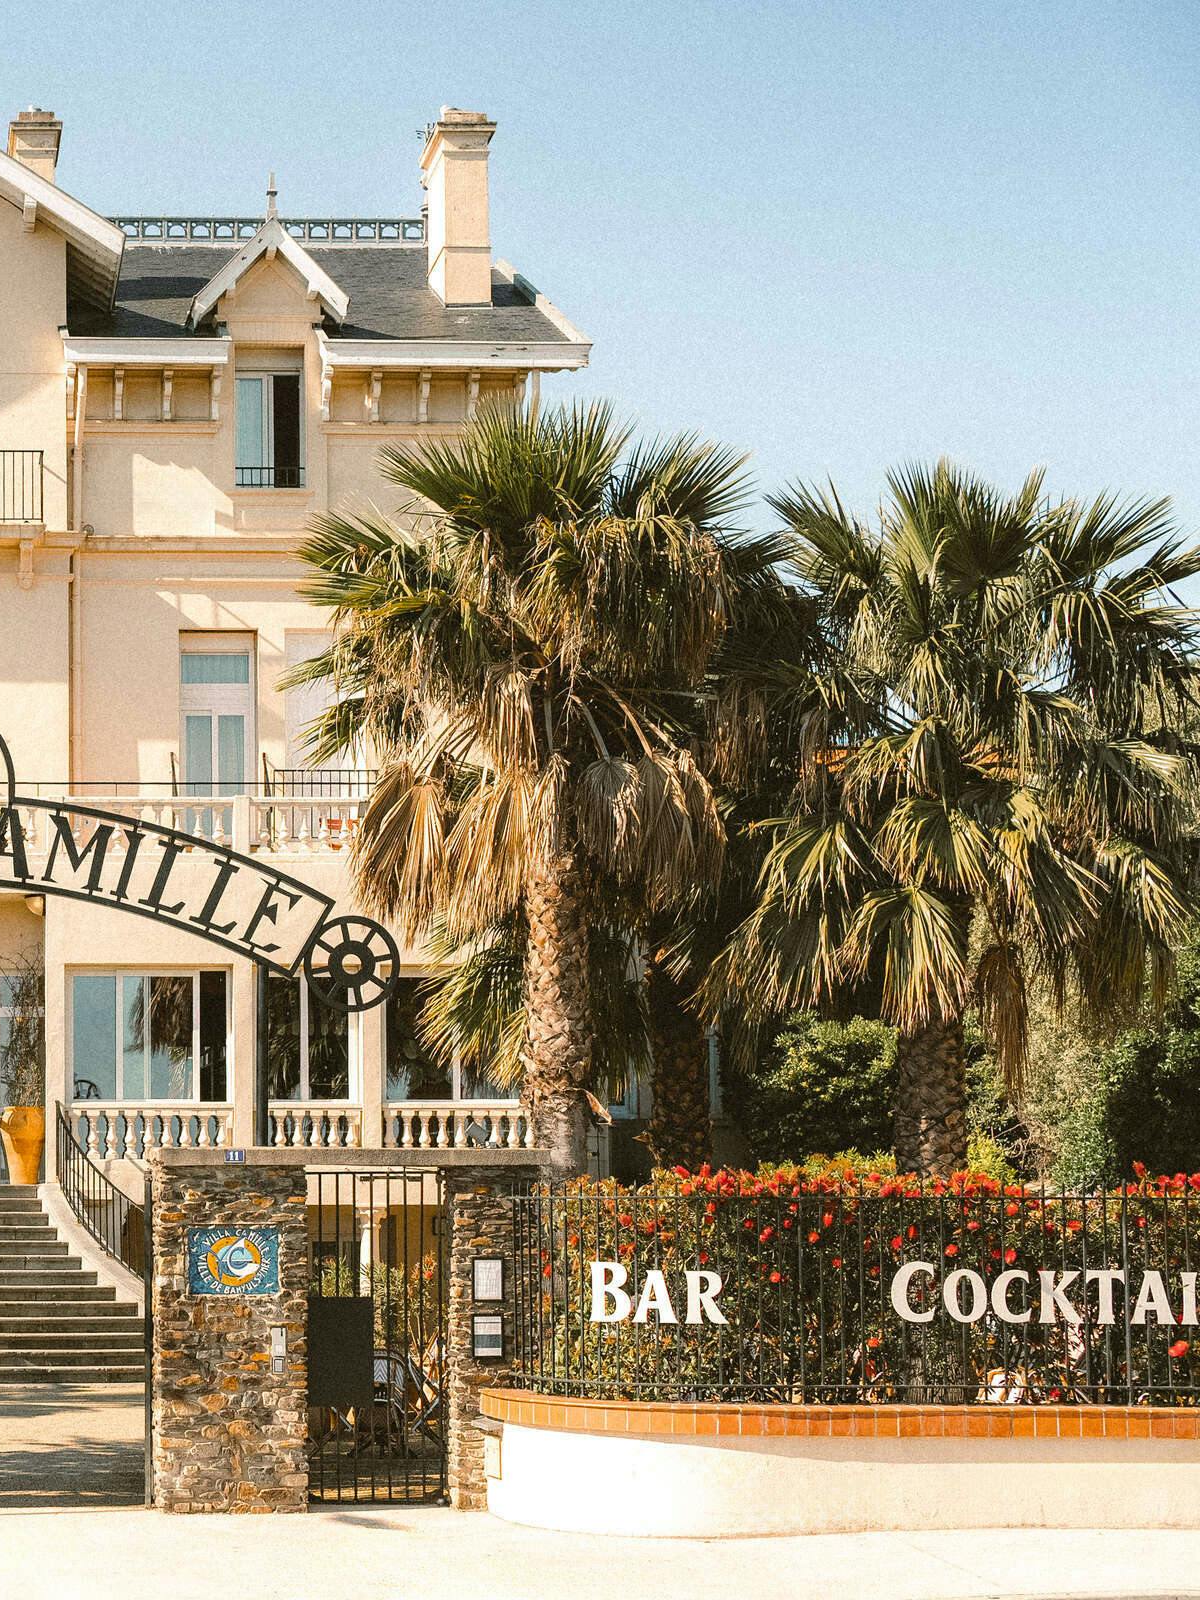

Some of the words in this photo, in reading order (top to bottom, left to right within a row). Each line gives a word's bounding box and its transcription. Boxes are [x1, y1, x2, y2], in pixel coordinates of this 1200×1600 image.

[229, 1151, 239, 1160] 11
[202, 1230, 230, 1247] VILLA
[197, 1254, 213, 1283] VILLE
[210, 1280, 222, 1292] DE
[589, 1261, 729, 1325] BAR
[891, 1261, 1200, 1326] COCKTAI
